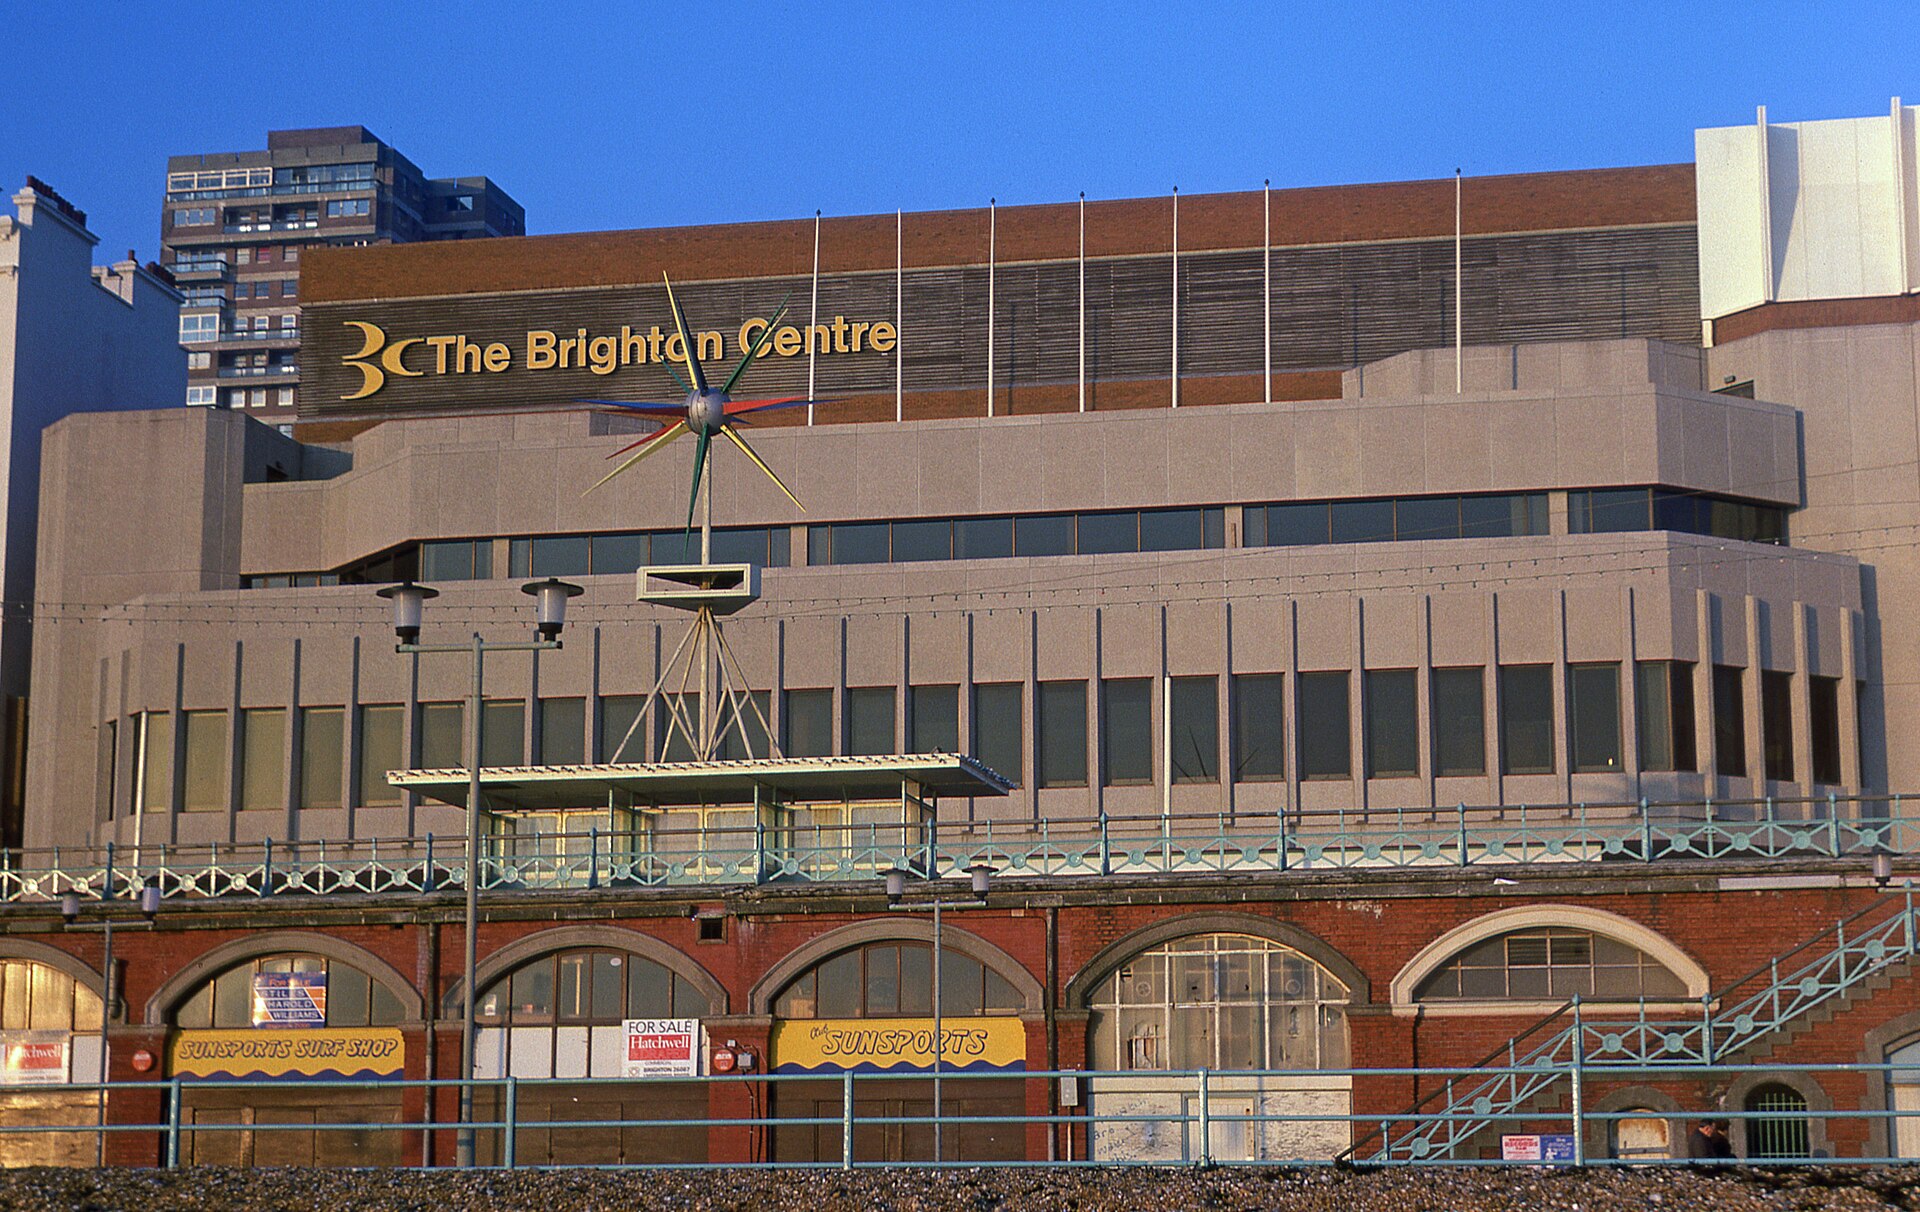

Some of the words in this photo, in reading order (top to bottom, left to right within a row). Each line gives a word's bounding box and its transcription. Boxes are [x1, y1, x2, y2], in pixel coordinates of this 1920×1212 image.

[427, 335, 510, 374] The
[527, 324, 723, 375] Brighton
[739, 315, 897, 358] Centre
[267, 1000, 312, 1008] HAROLD
[272, 1011, 318, 1019] WILLIAMS
[629, 1021, 655, 1033] FOR
[658, 1021, 692, 1033] SALE
[179, 1039, 294, 1059] SUNSPORTS
[295, 1039, 347, 1058] SURF
[347, 1038, 399, 1057] SHOP
[630, 1035, 690, 1049] Hatchwell
[821, 1029, 988, 1055] SUNSPORTS
[7, 1044, 61, 1058] tchwell
